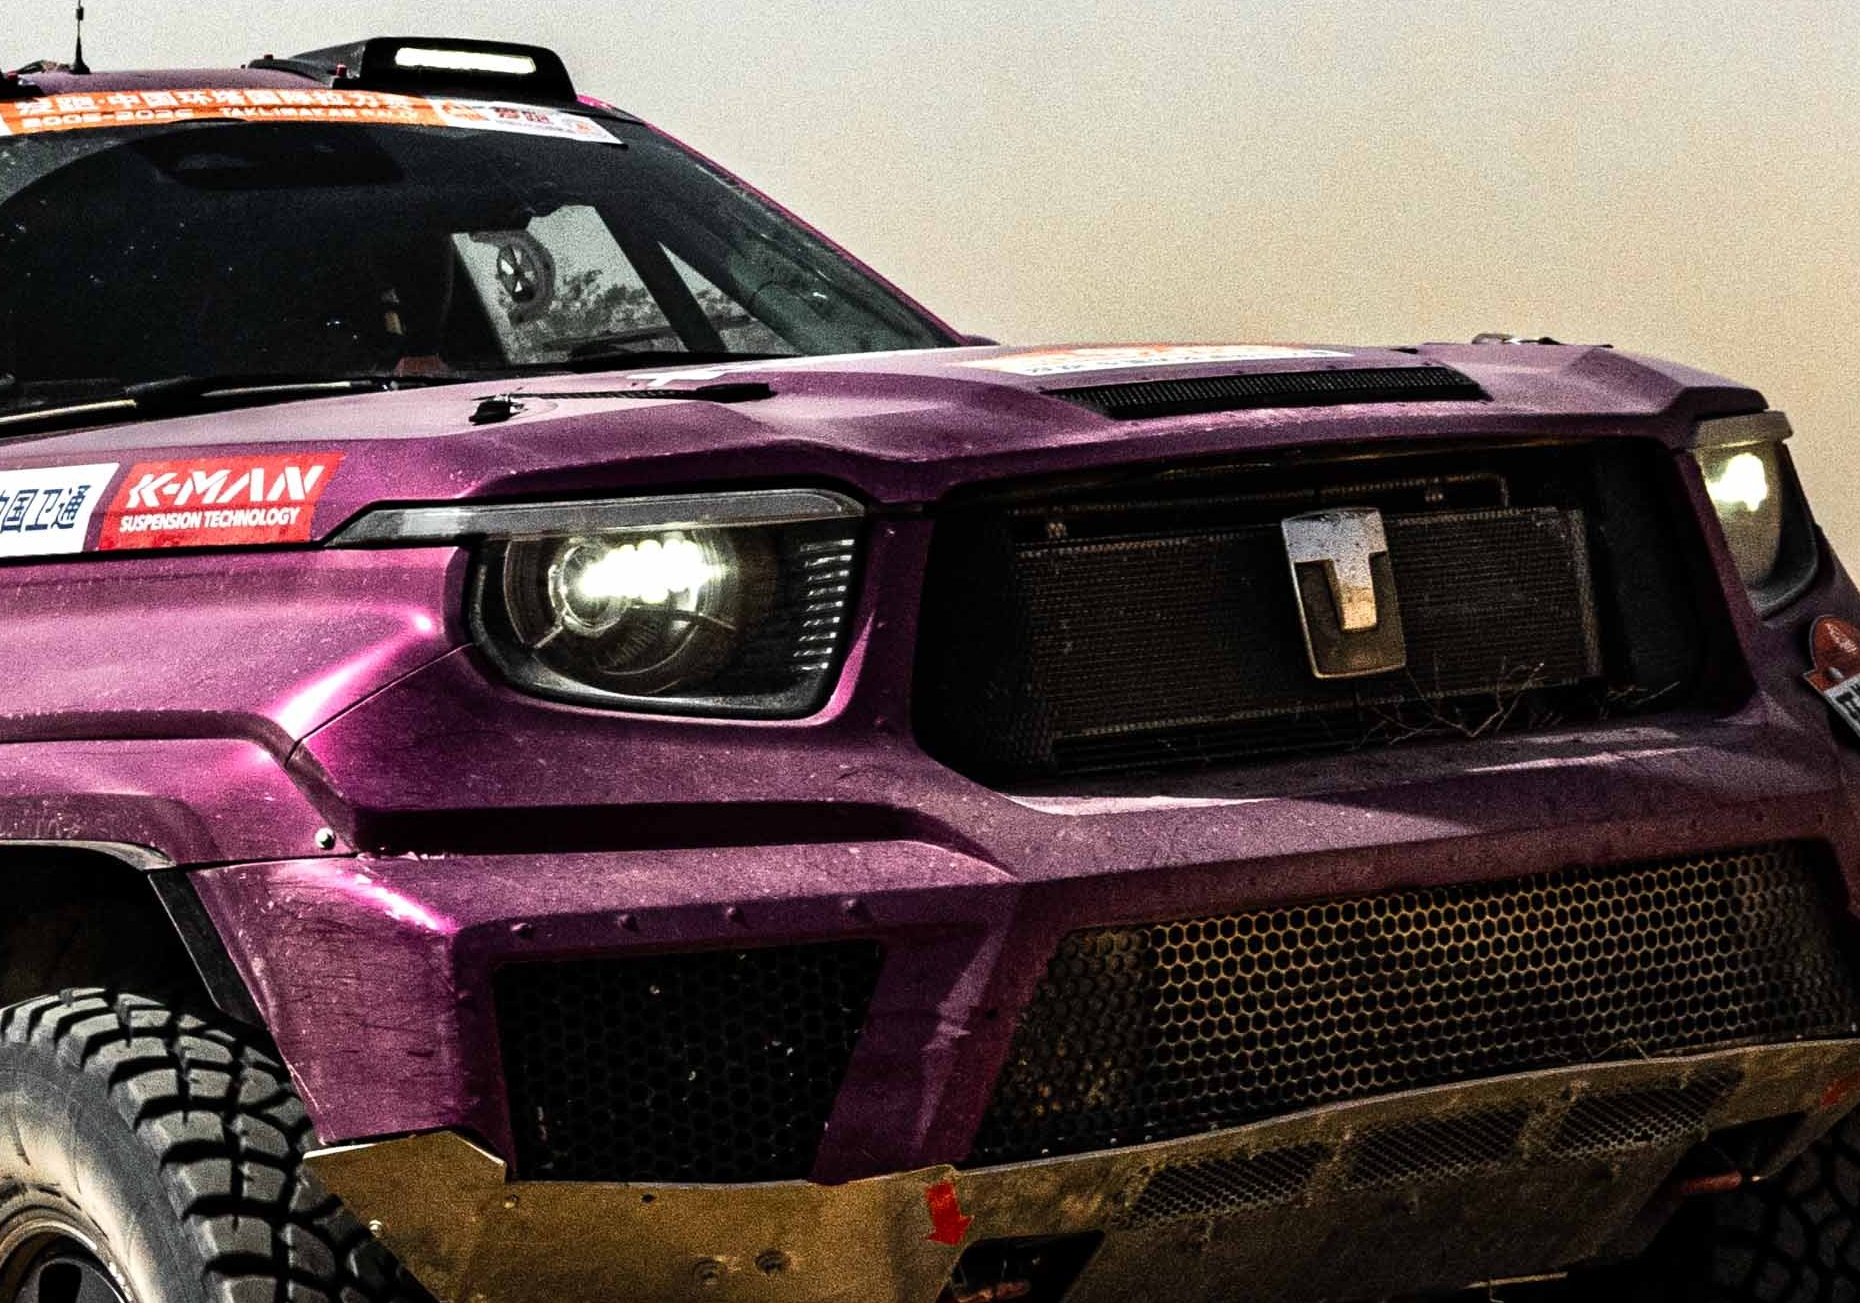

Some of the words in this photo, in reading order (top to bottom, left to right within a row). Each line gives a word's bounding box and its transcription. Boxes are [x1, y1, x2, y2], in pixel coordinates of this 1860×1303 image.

[126, 464, 326, 508] K-MAN
[119, 510, 201, 532] SUSPENSION
[204, 506, 301, 528] TECHNOLOGY
